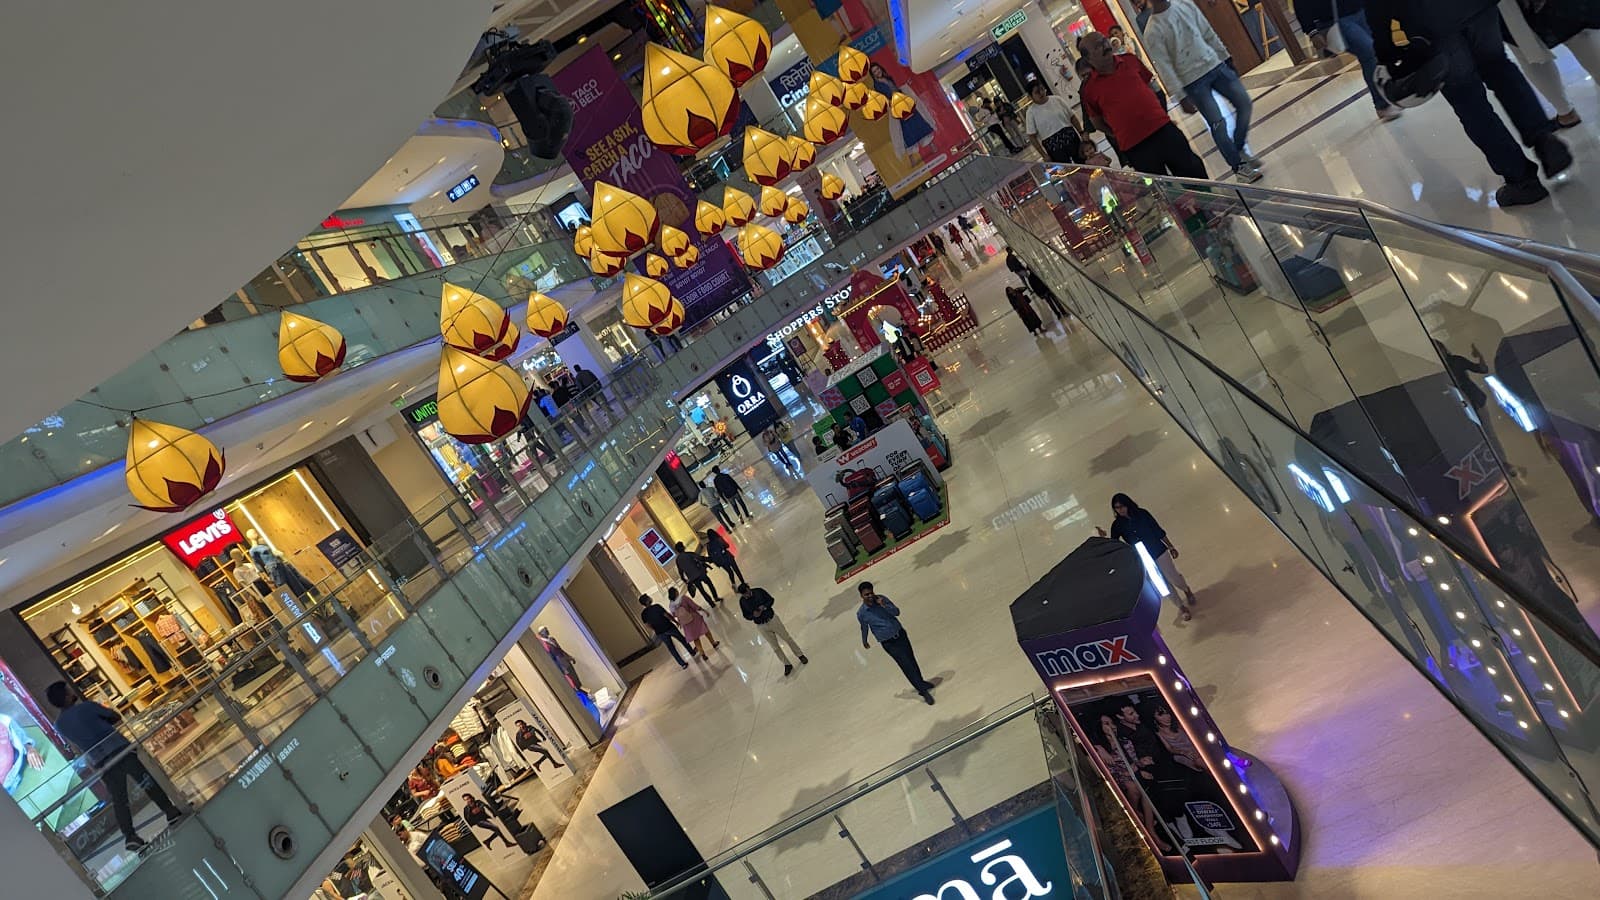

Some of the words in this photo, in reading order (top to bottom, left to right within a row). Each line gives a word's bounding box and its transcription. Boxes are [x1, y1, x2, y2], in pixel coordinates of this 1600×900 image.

[572, 79, 598, 100] TACO
[579, 87, 604, 108] BELL
[781, 83, 810, 108] Ciné
[586, 140, 609, 160] SEE
[605, 134, 616, 149] A
[583, 148, 620, 180] CATCH
[617, 143, 628, 156] A
[411, 399, 438, 421] UNITED
[736, 391, 765, 413] ORRA
[886, 450, 898, 459] FOR
[888, 449, 908, 464] EVERY
[1036, 635, 1141, 677] max
